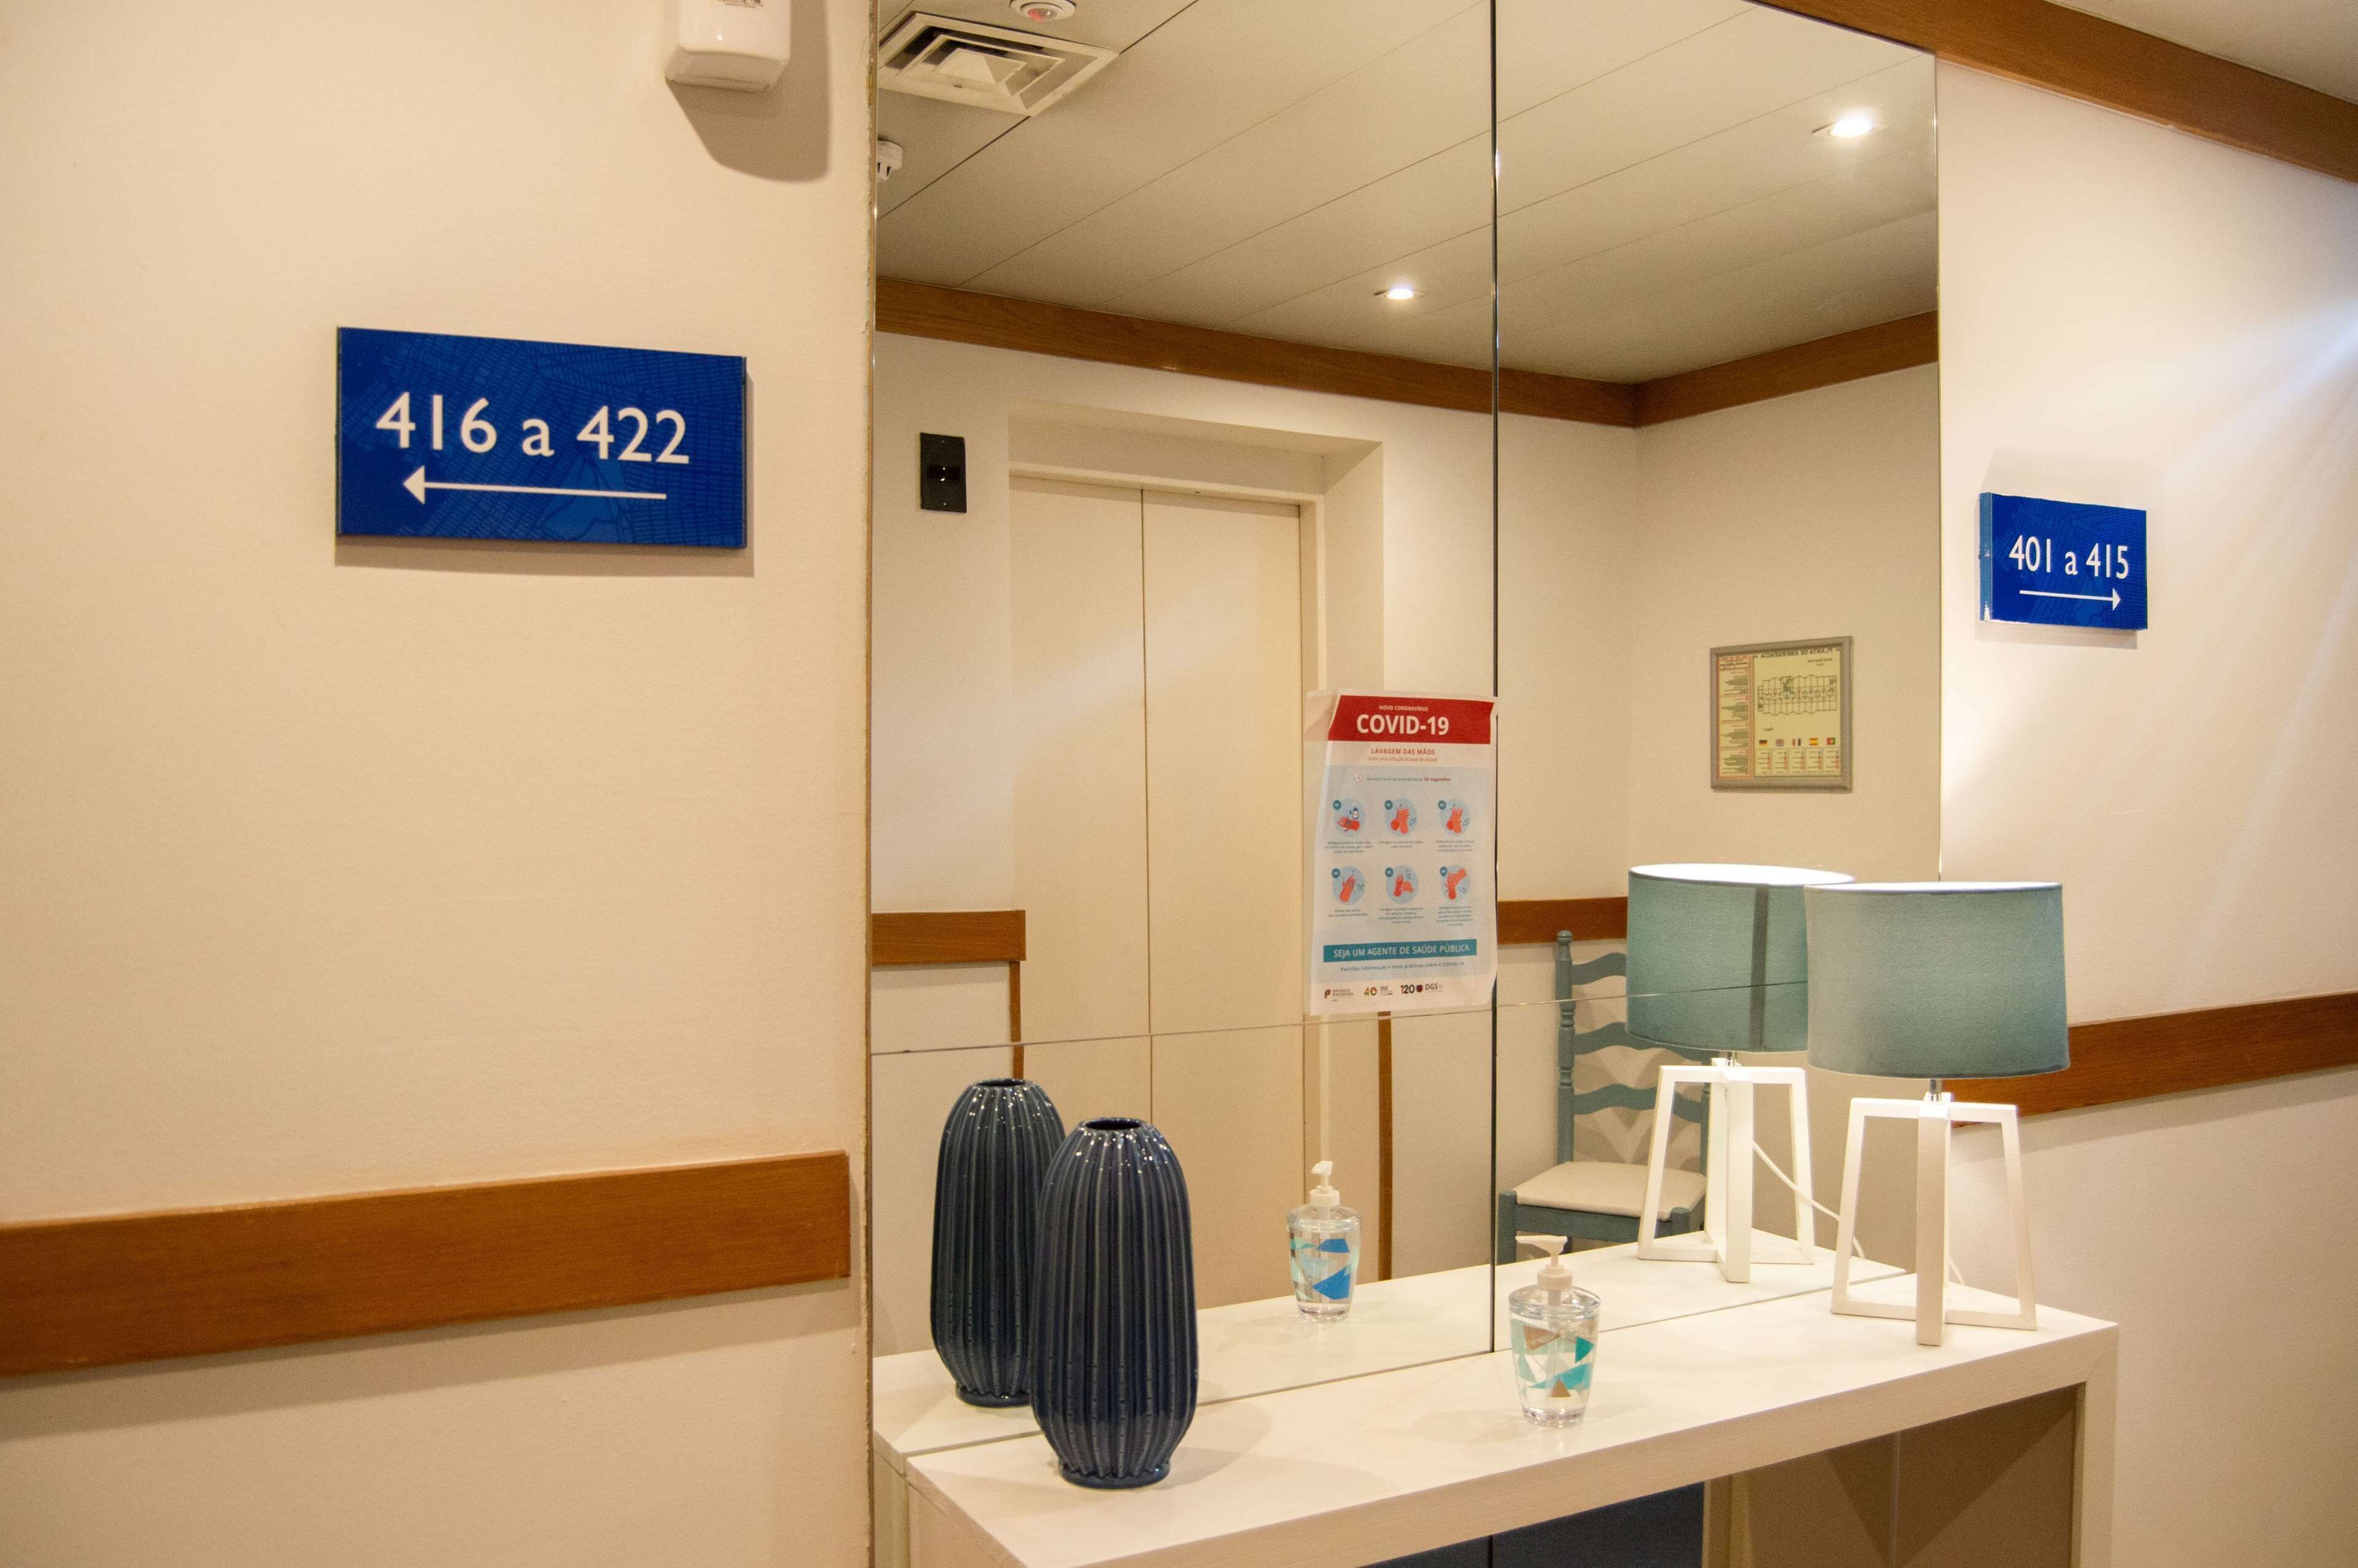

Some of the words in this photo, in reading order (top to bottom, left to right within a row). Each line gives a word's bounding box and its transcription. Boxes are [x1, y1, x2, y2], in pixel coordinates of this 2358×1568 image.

[375, 391, 497, 453] 416
[521, 418, 555, 456] a
[576, 405, 689, 464] 422
[2009, 535, 2051, 572] 401
[2064, 552, 2079, 575] a
[2085, 543, 2129, 579] 415
[1356, 714, 1450, 736] COVID-19
[1333, 949, 1351, 959] SEJA
[1367, 946, 1397, 956] AGENTE
[1412, 944, 1437, 954] SAÚDE
[1439, 943, 1469, 953] PÚBLICA
[1400, 985, 1415, 994] 120
